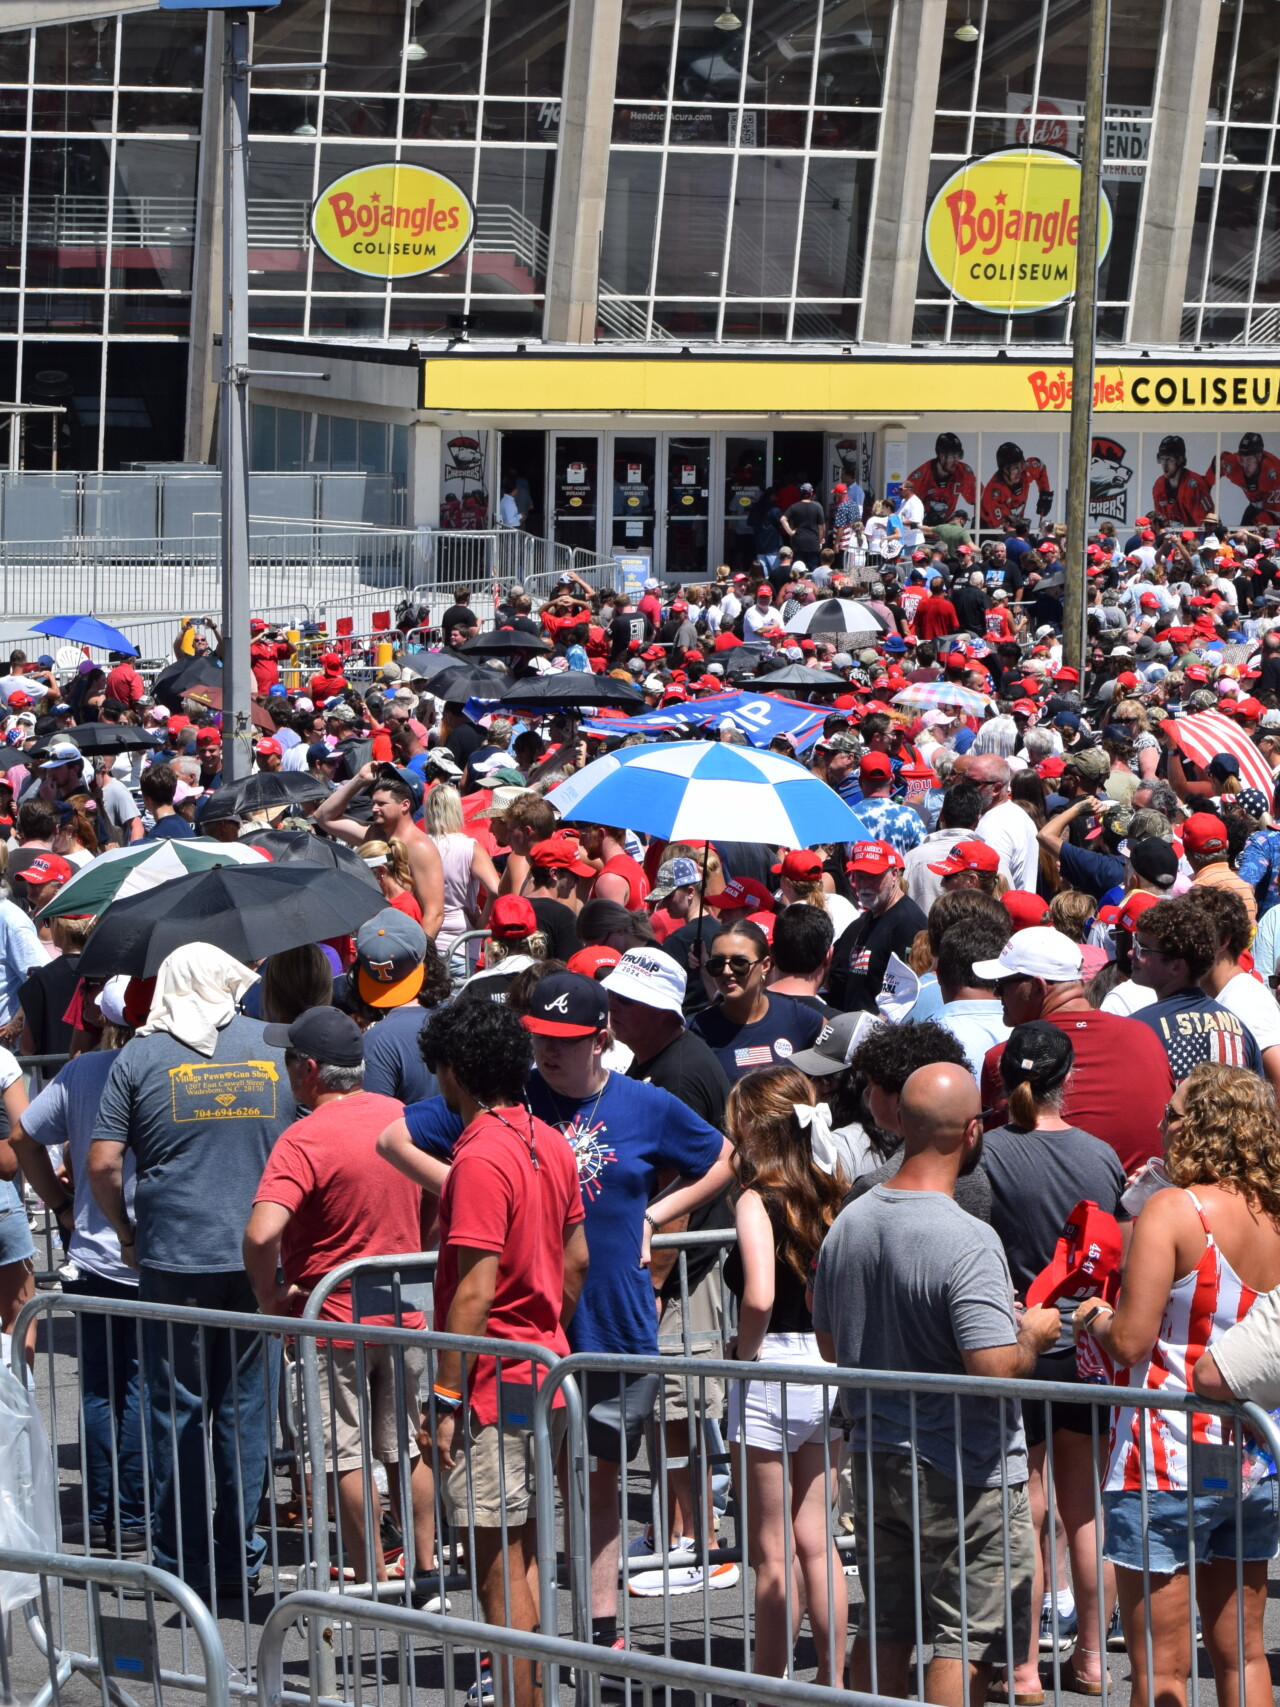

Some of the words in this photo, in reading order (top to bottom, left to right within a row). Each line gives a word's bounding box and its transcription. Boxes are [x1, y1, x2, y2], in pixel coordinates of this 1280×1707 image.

[630, 111, 713, 122] HendricAcura.com
[327, 191, 460, 238] Bojangles
[945, 189, 1080, 256] Bojangle
[353, 242, 437, 256] COLISEUM
[970, 263, 1069, 281] COLISEUM
[1027, 370, 1124, 410] Bojagles
[446, 468, 480, 479] CHECKERS
[1267, 490, 1280, 505] 22
[907, 779, 931, 791] YOU
[595, 957, 616, 965] TRUMP
[621, 953, 660, 974] TRUMP
[369, 960, 394, 981] T
[622, 967, 640, 978] 2024
[544, 992, 569, 1014] A
[1159, 1016, 1171, 1039] I
[1175, 1011, 1244, 1036] STAND
[175, 1074, 201, 1083] Village
[252, 1070, 270, 1080] Shop
[218, 1080, 244, 1088] Caswell
[193, 1107, 261, 1118] 704-694-6266
[1082, 1243, 1102, 1275] 45-47
